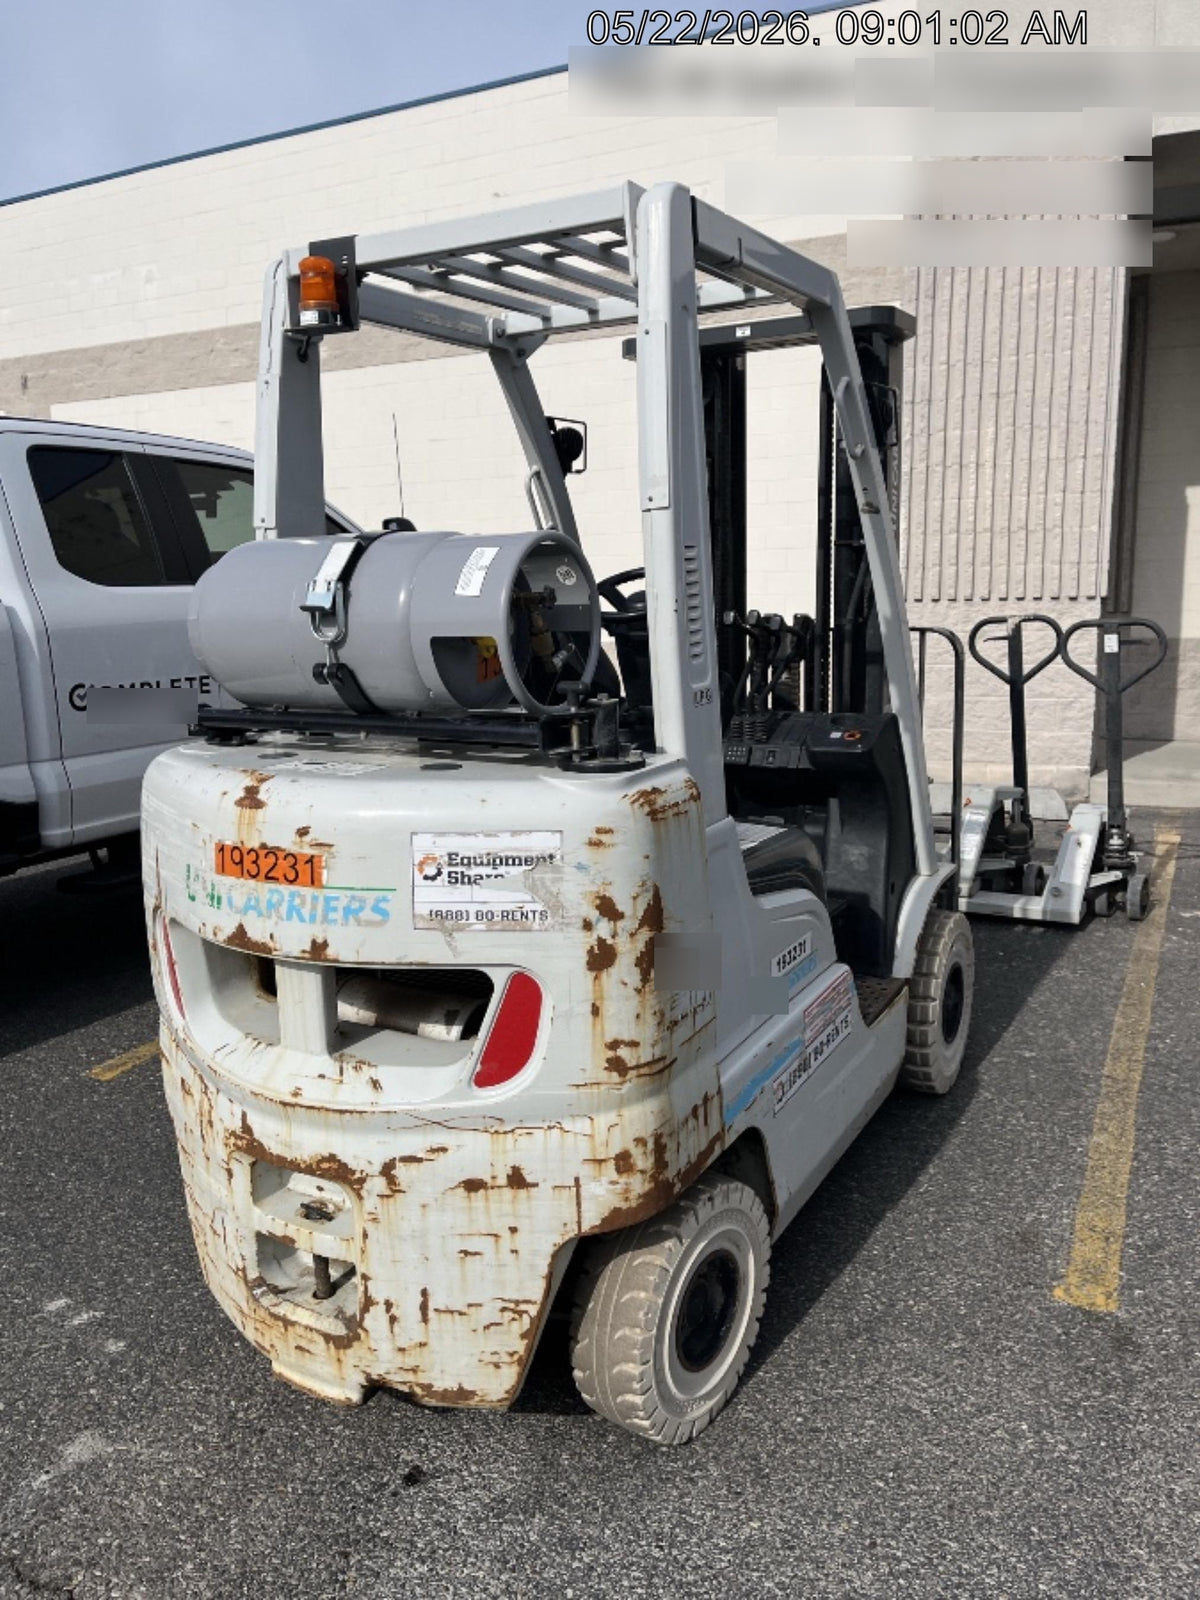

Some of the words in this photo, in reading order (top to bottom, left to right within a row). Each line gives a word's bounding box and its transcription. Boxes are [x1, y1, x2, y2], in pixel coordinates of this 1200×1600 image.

[217, 843, 316, 886] 193231
[475, 909, 548, 922] 80-RENTS
[776, 939, 807, 973] 193231
